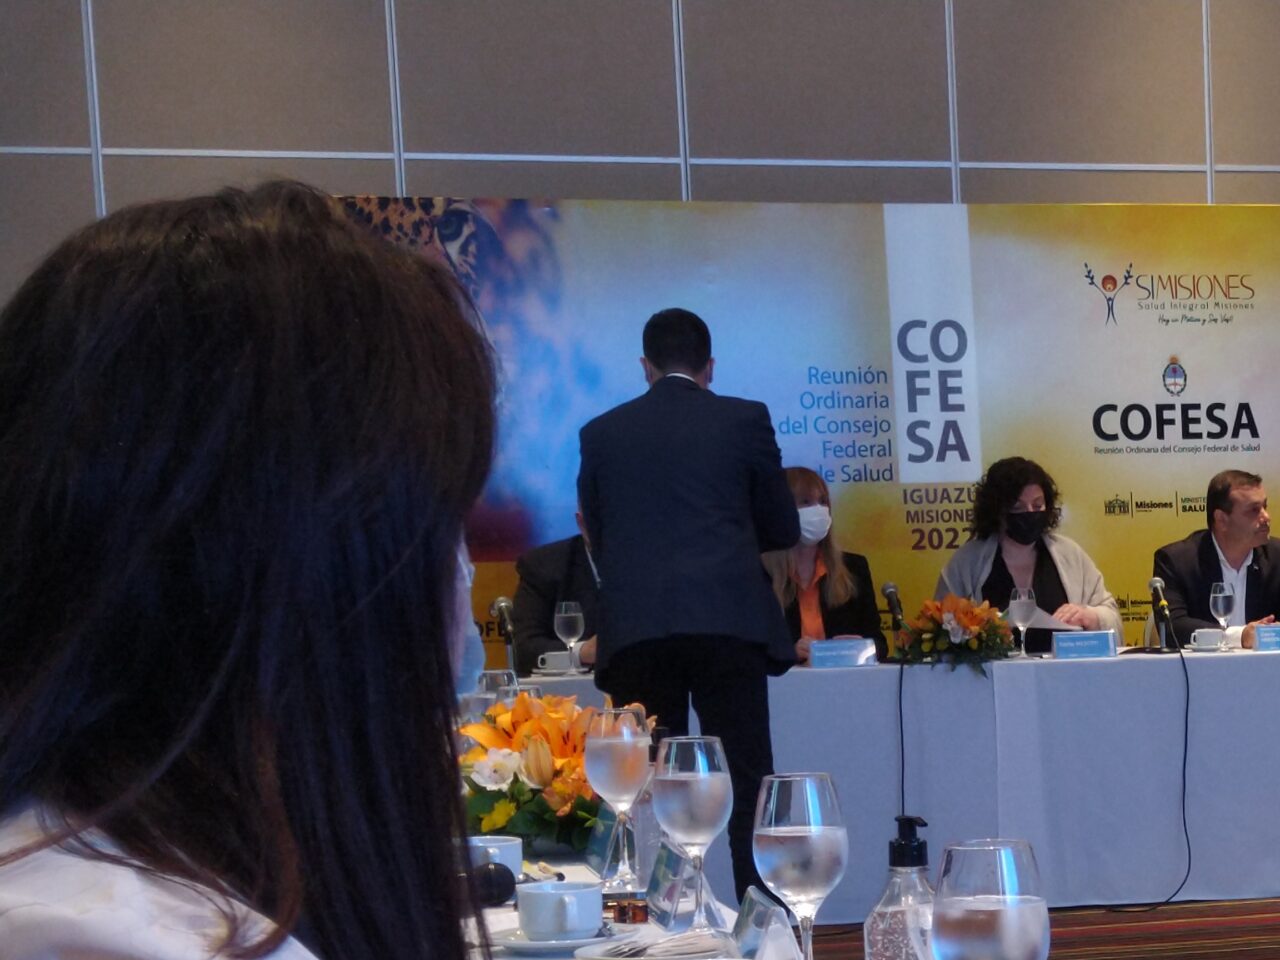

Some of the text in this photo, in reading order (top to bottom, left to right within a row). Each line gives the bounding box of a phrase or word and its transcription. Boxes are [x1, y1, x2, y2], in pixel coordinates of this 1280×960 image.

[1137, 301, 1255, 311] Salud Integral Misiones
[896, 319, 969, 363] CO
[807, 364, 889, 385] Reunión
[799, 391, 890, 411] Ordinaria
[905, 369, 966, 414] FE
[778, 415, 892, 437] del Consejo
[1092, 401, 1260, 442] COFESA
[821, 439, 893, 459] Federal
[906, 419, 971, 464] SA
[1160, 445, 1172, 453] del
[1203, 444, 1229, 452] Federal
[1230, 444, 1240, 452] de
[1240, 443, 1261, 452] Salud
[841, 463, 895, 483] Salud
[1135, 500, 1174, 510] Misiones
[1181, 505, 1206, 513] SALU
[906, 508, 975, 524] MISIONE
